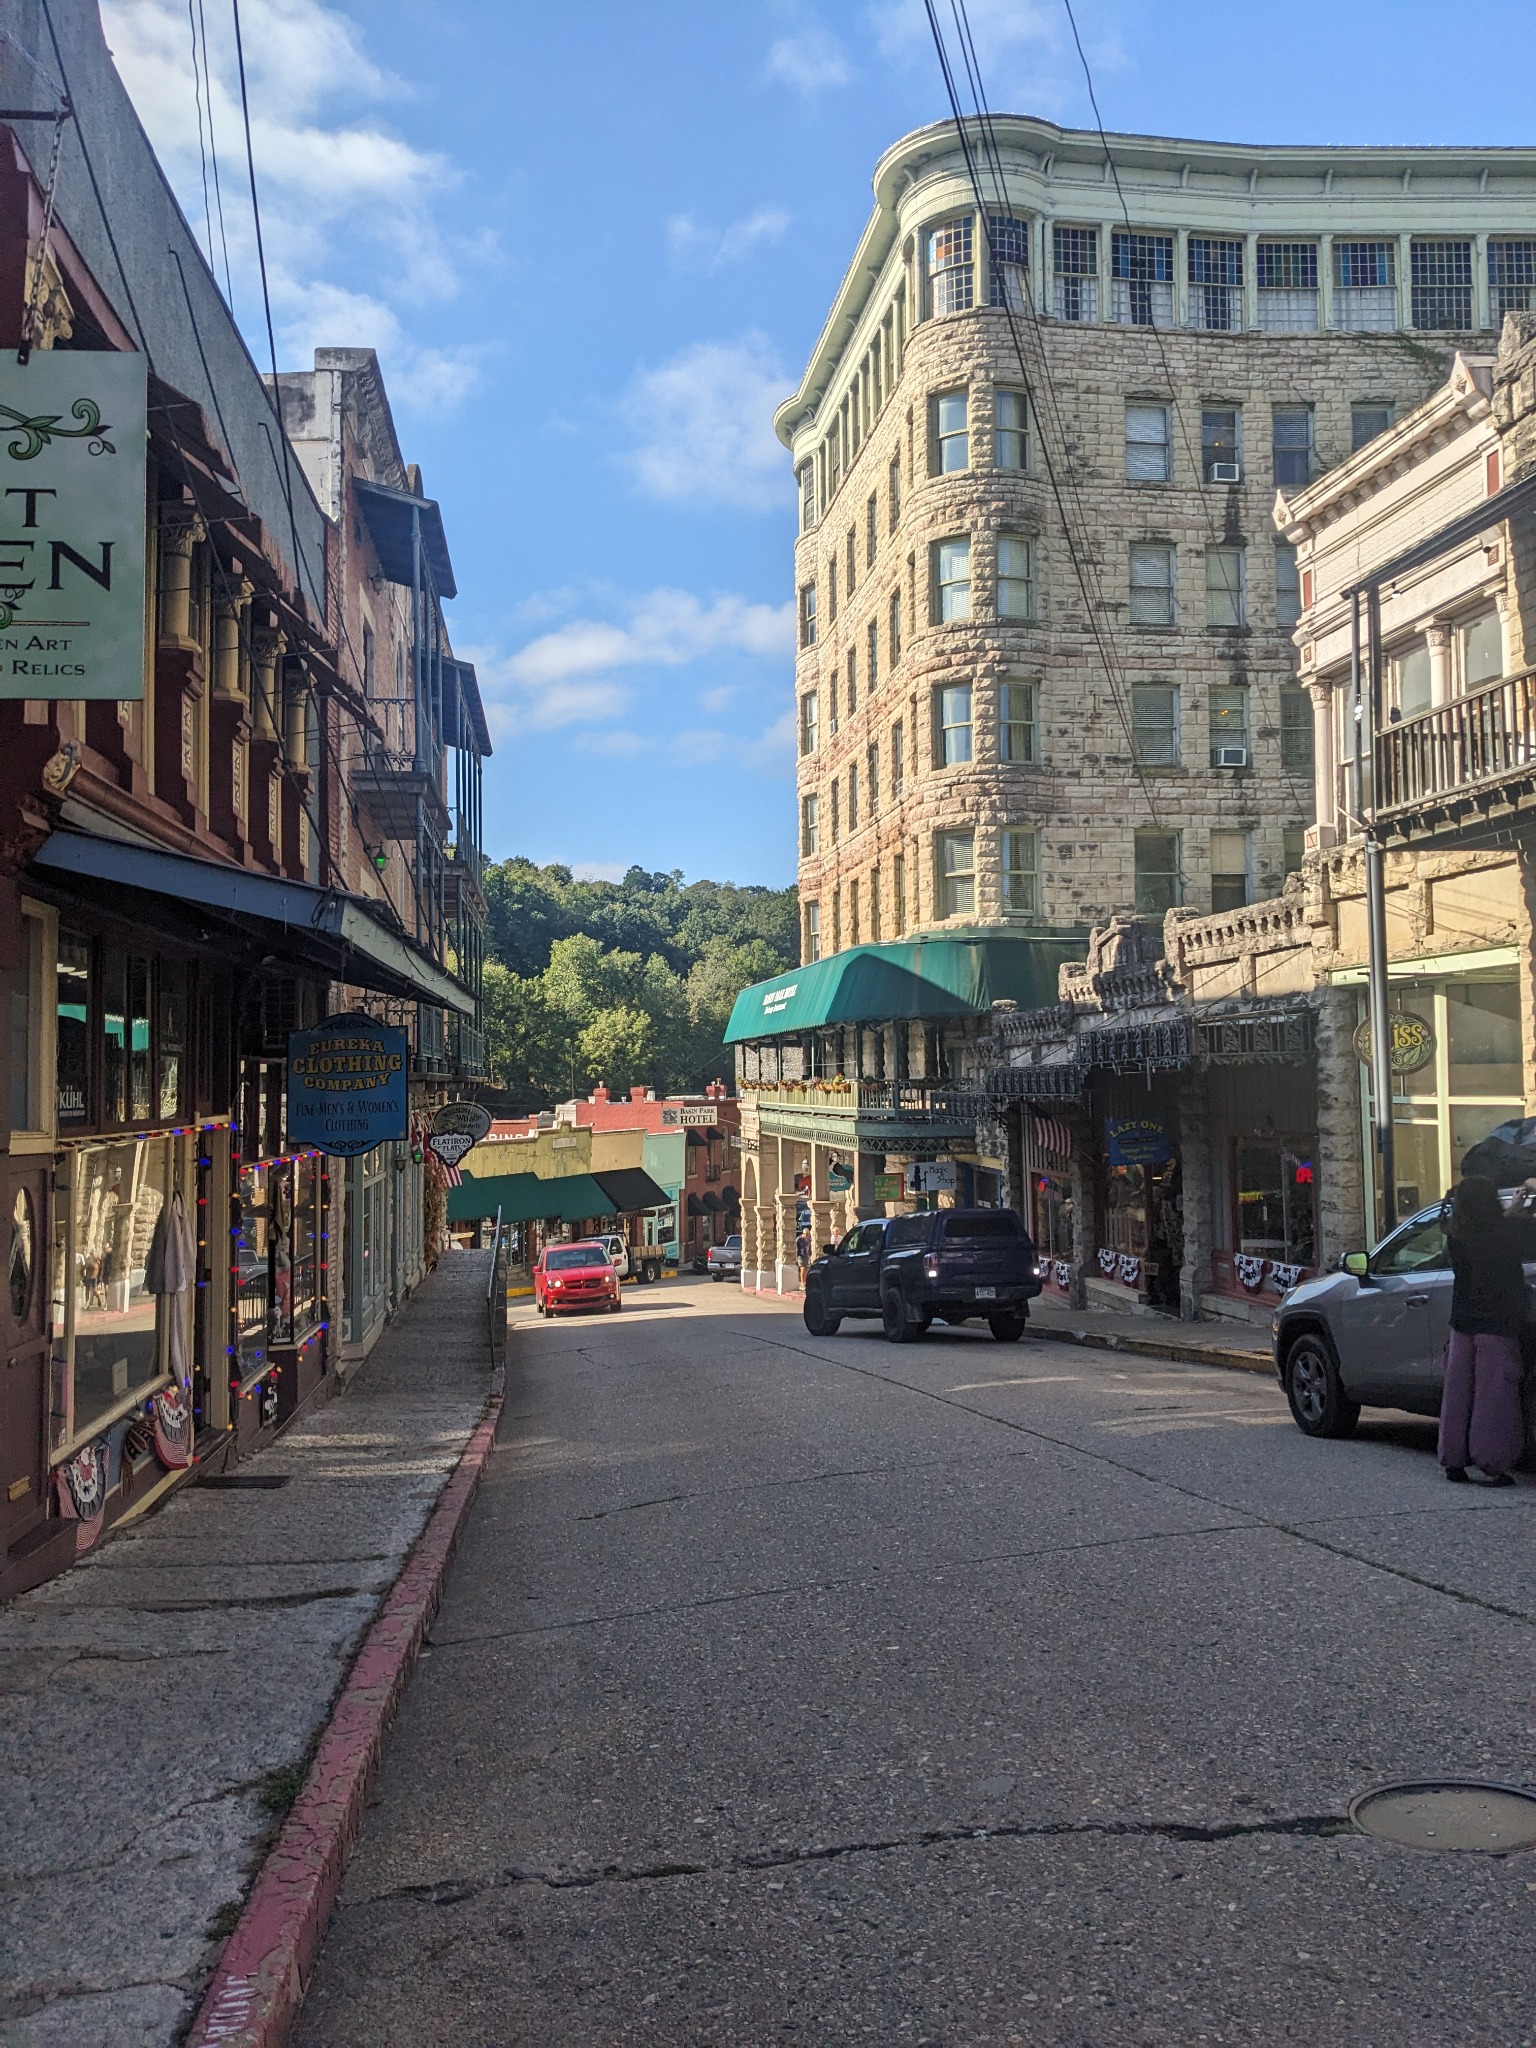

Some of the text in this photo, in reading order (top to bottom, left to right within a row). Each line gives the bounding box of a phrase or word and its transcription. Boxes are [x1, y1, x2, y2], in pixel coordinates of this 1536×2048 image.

[25, 635, 72, 651] ART
[12, 659, 85, 676] RELICS
[309, 1039, 384, 1054] EUREKA
[292, 1053, 402, 1075] CLOTHING
[303, 1072, 391, 1091] COMPANY
[59, 1084, 85, 1109] KÜHL
[296, 1099, 399, 1117] FINE MEN'S & WOMEN'S
[325, 1118, 369, 1131] CLOTHING
[680, 1115, 715, 1124] HOTEL
[1109, 1119, 1165, 1138] LAZY ONE
[433, 1138, 470, 1146] FLATIRON
[442, 1145, 462, 1154] FLATS
[929, 1166, 948, 1177] Magic
[937, 1175, 956, 1188] Shop
